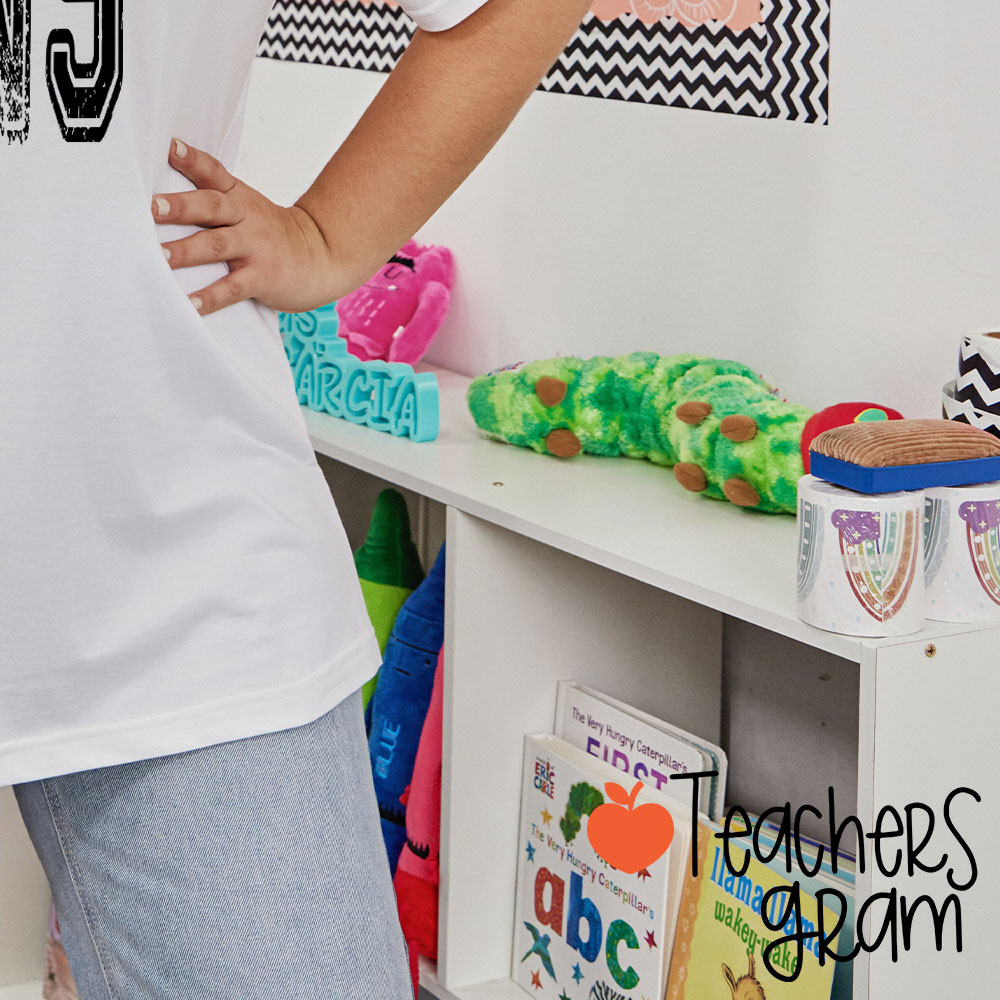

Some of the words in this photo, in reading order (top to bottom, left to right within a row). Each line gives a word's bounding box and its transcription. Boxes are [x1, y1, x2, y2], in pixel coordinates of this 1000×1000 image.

[287, 346, 420, 437] ARCIA
[375, 719, 401, 778] BLUE
[534, 761, 556, 786] ERIC
[572, 706, 586, 725] The
[586, 713, 605, 735] Very
[605, 726, 635, 750] Hungry
[636, 739, 688, 775] Caterpillar's
[533, 775, 556, 800] CARLE
[531, 822, 545, 842] The
[546, 834, 566, 861] Very
[566, 850, 597, 884] Hungry
[598, 871, 655, 920] Caterpillar's
[534, 866, 641, 991] abc
